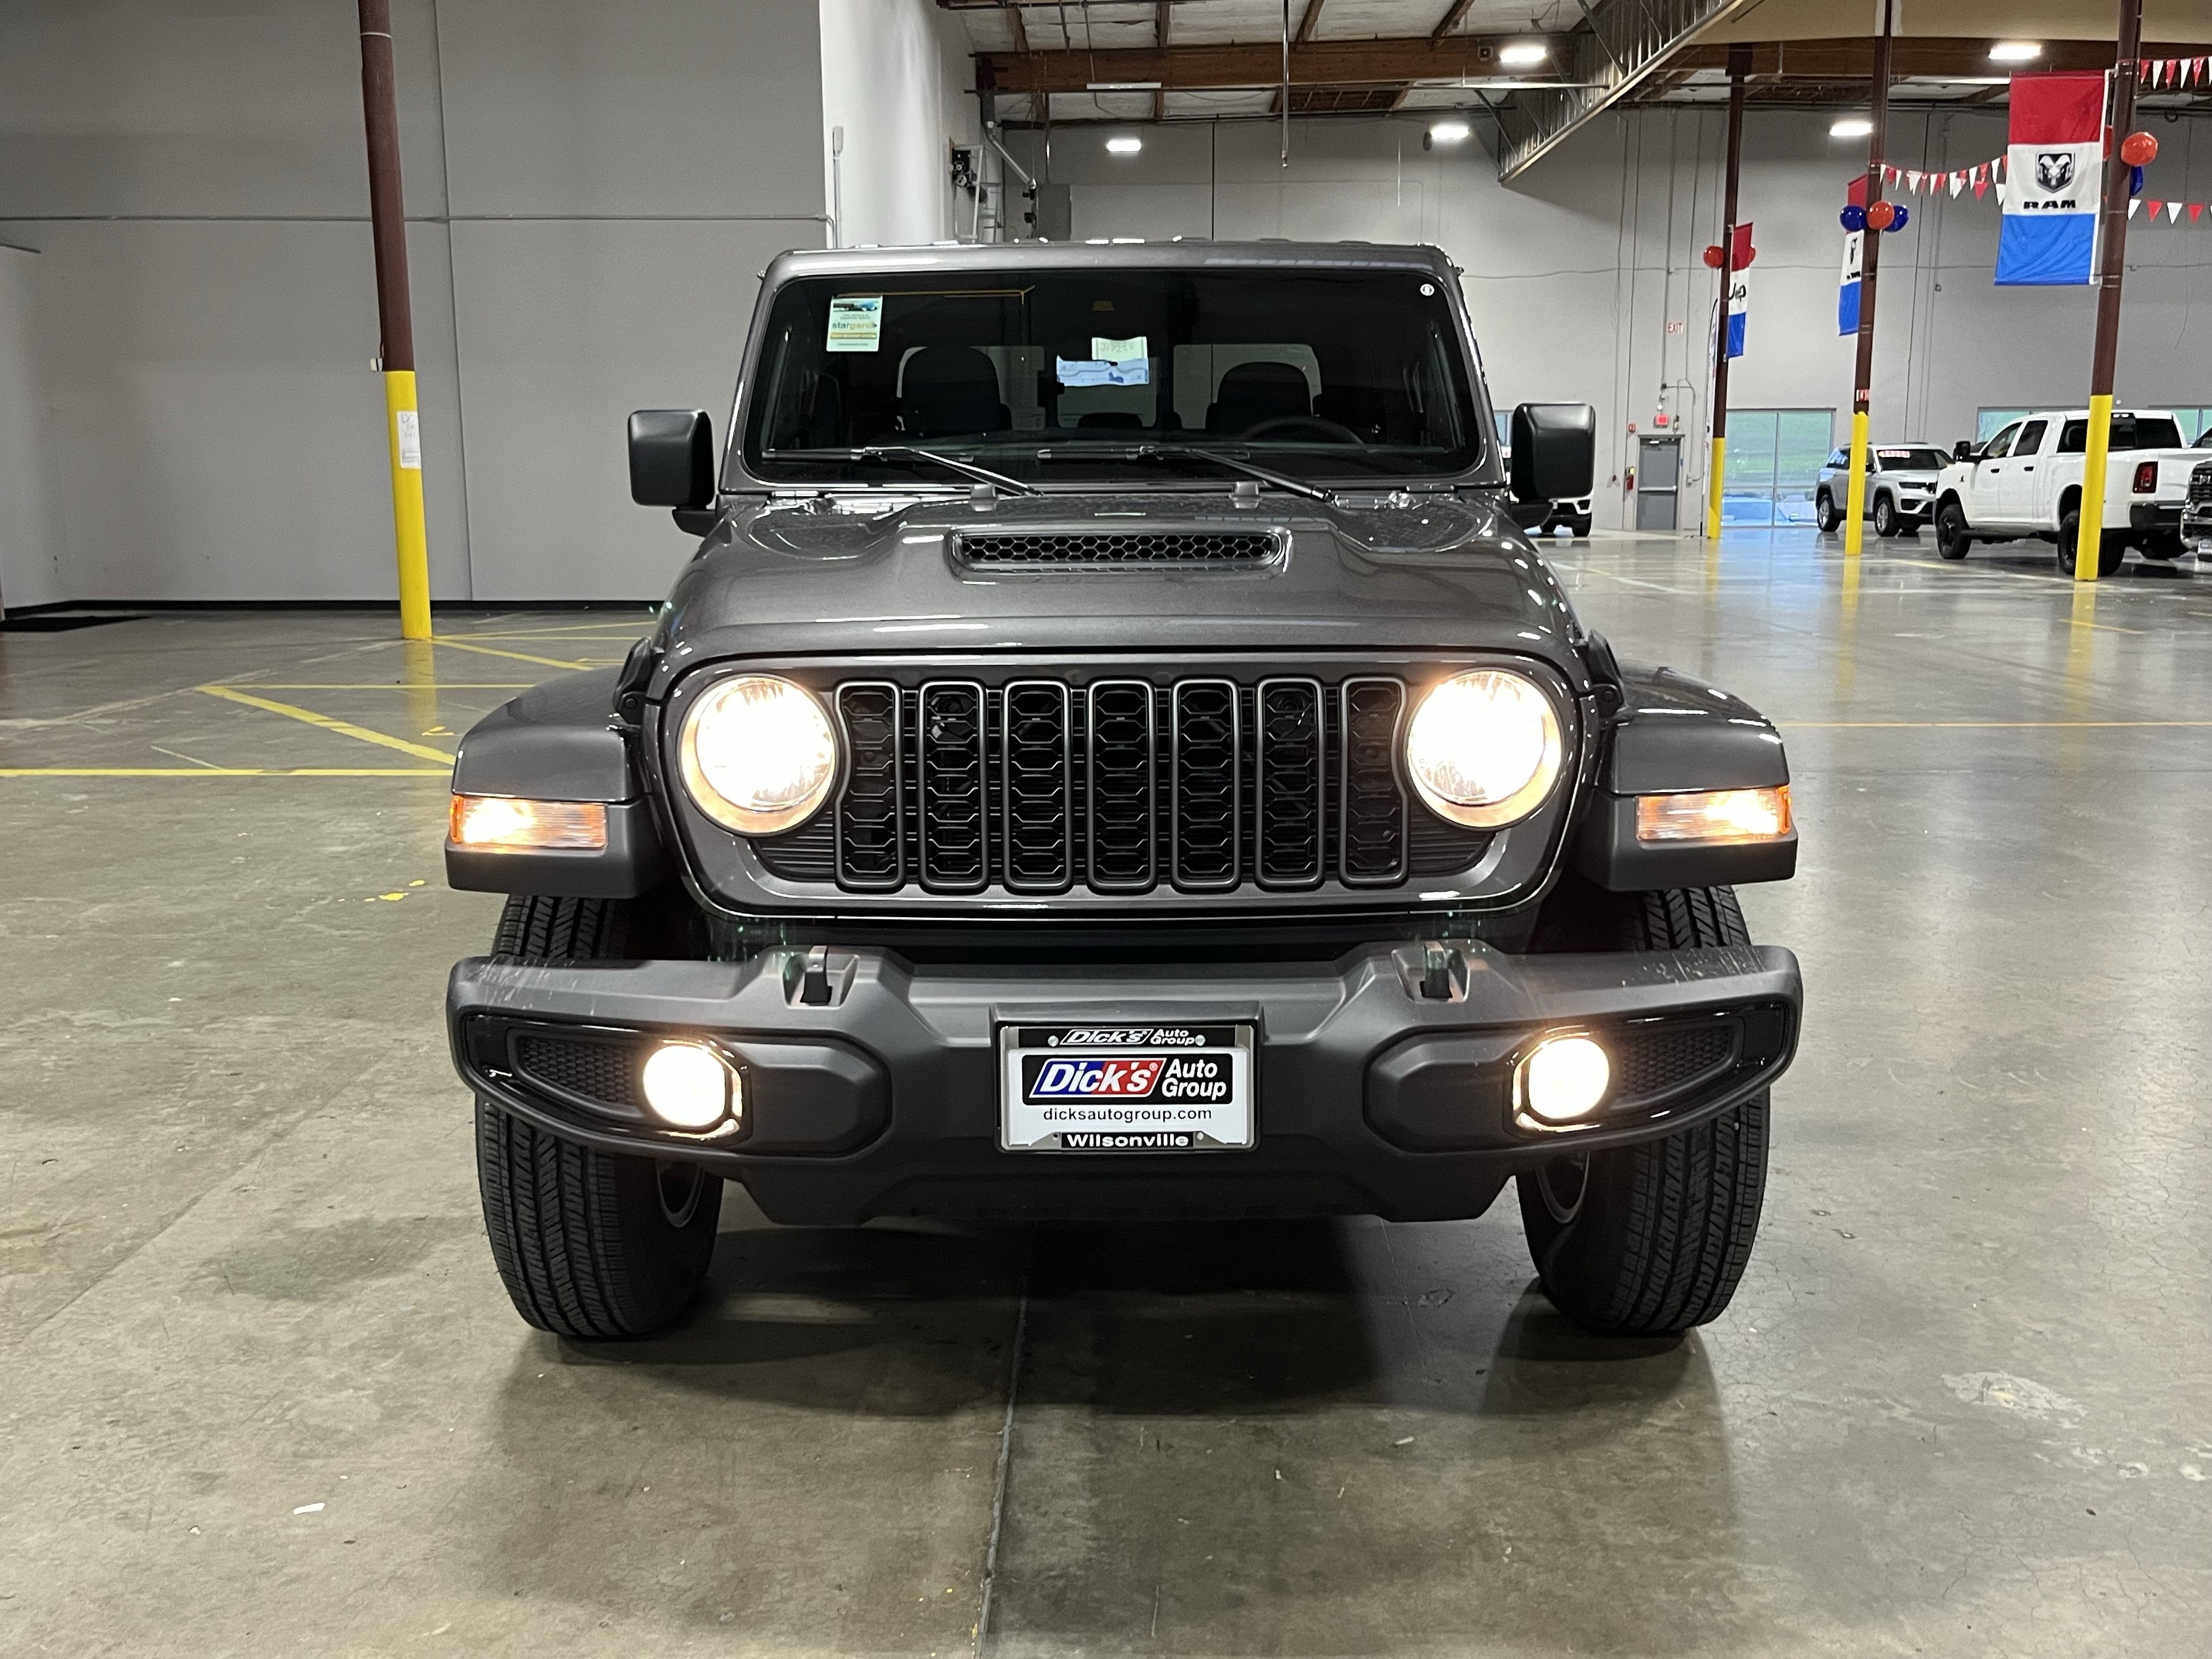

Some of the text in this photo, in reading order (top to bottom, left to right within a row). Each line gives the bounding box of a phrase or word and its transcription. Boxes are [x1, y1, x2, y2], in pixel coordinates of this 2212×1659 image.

[2023, 199, 2076, 210] RAM
[1668, 322, 1683, 334] EXIT
[1154, 1029, 1189, 1037] Auto
[1150, 1036, 1195, 1046] Group
[1165, 1058, 1217, 1078] Auto
[1161, 1078, 1227, 1101] Group
[1043, 1108, 1211, 1123] dicksautogroup.com
[1066, 1133, 1189, 1147] Wilsonville
